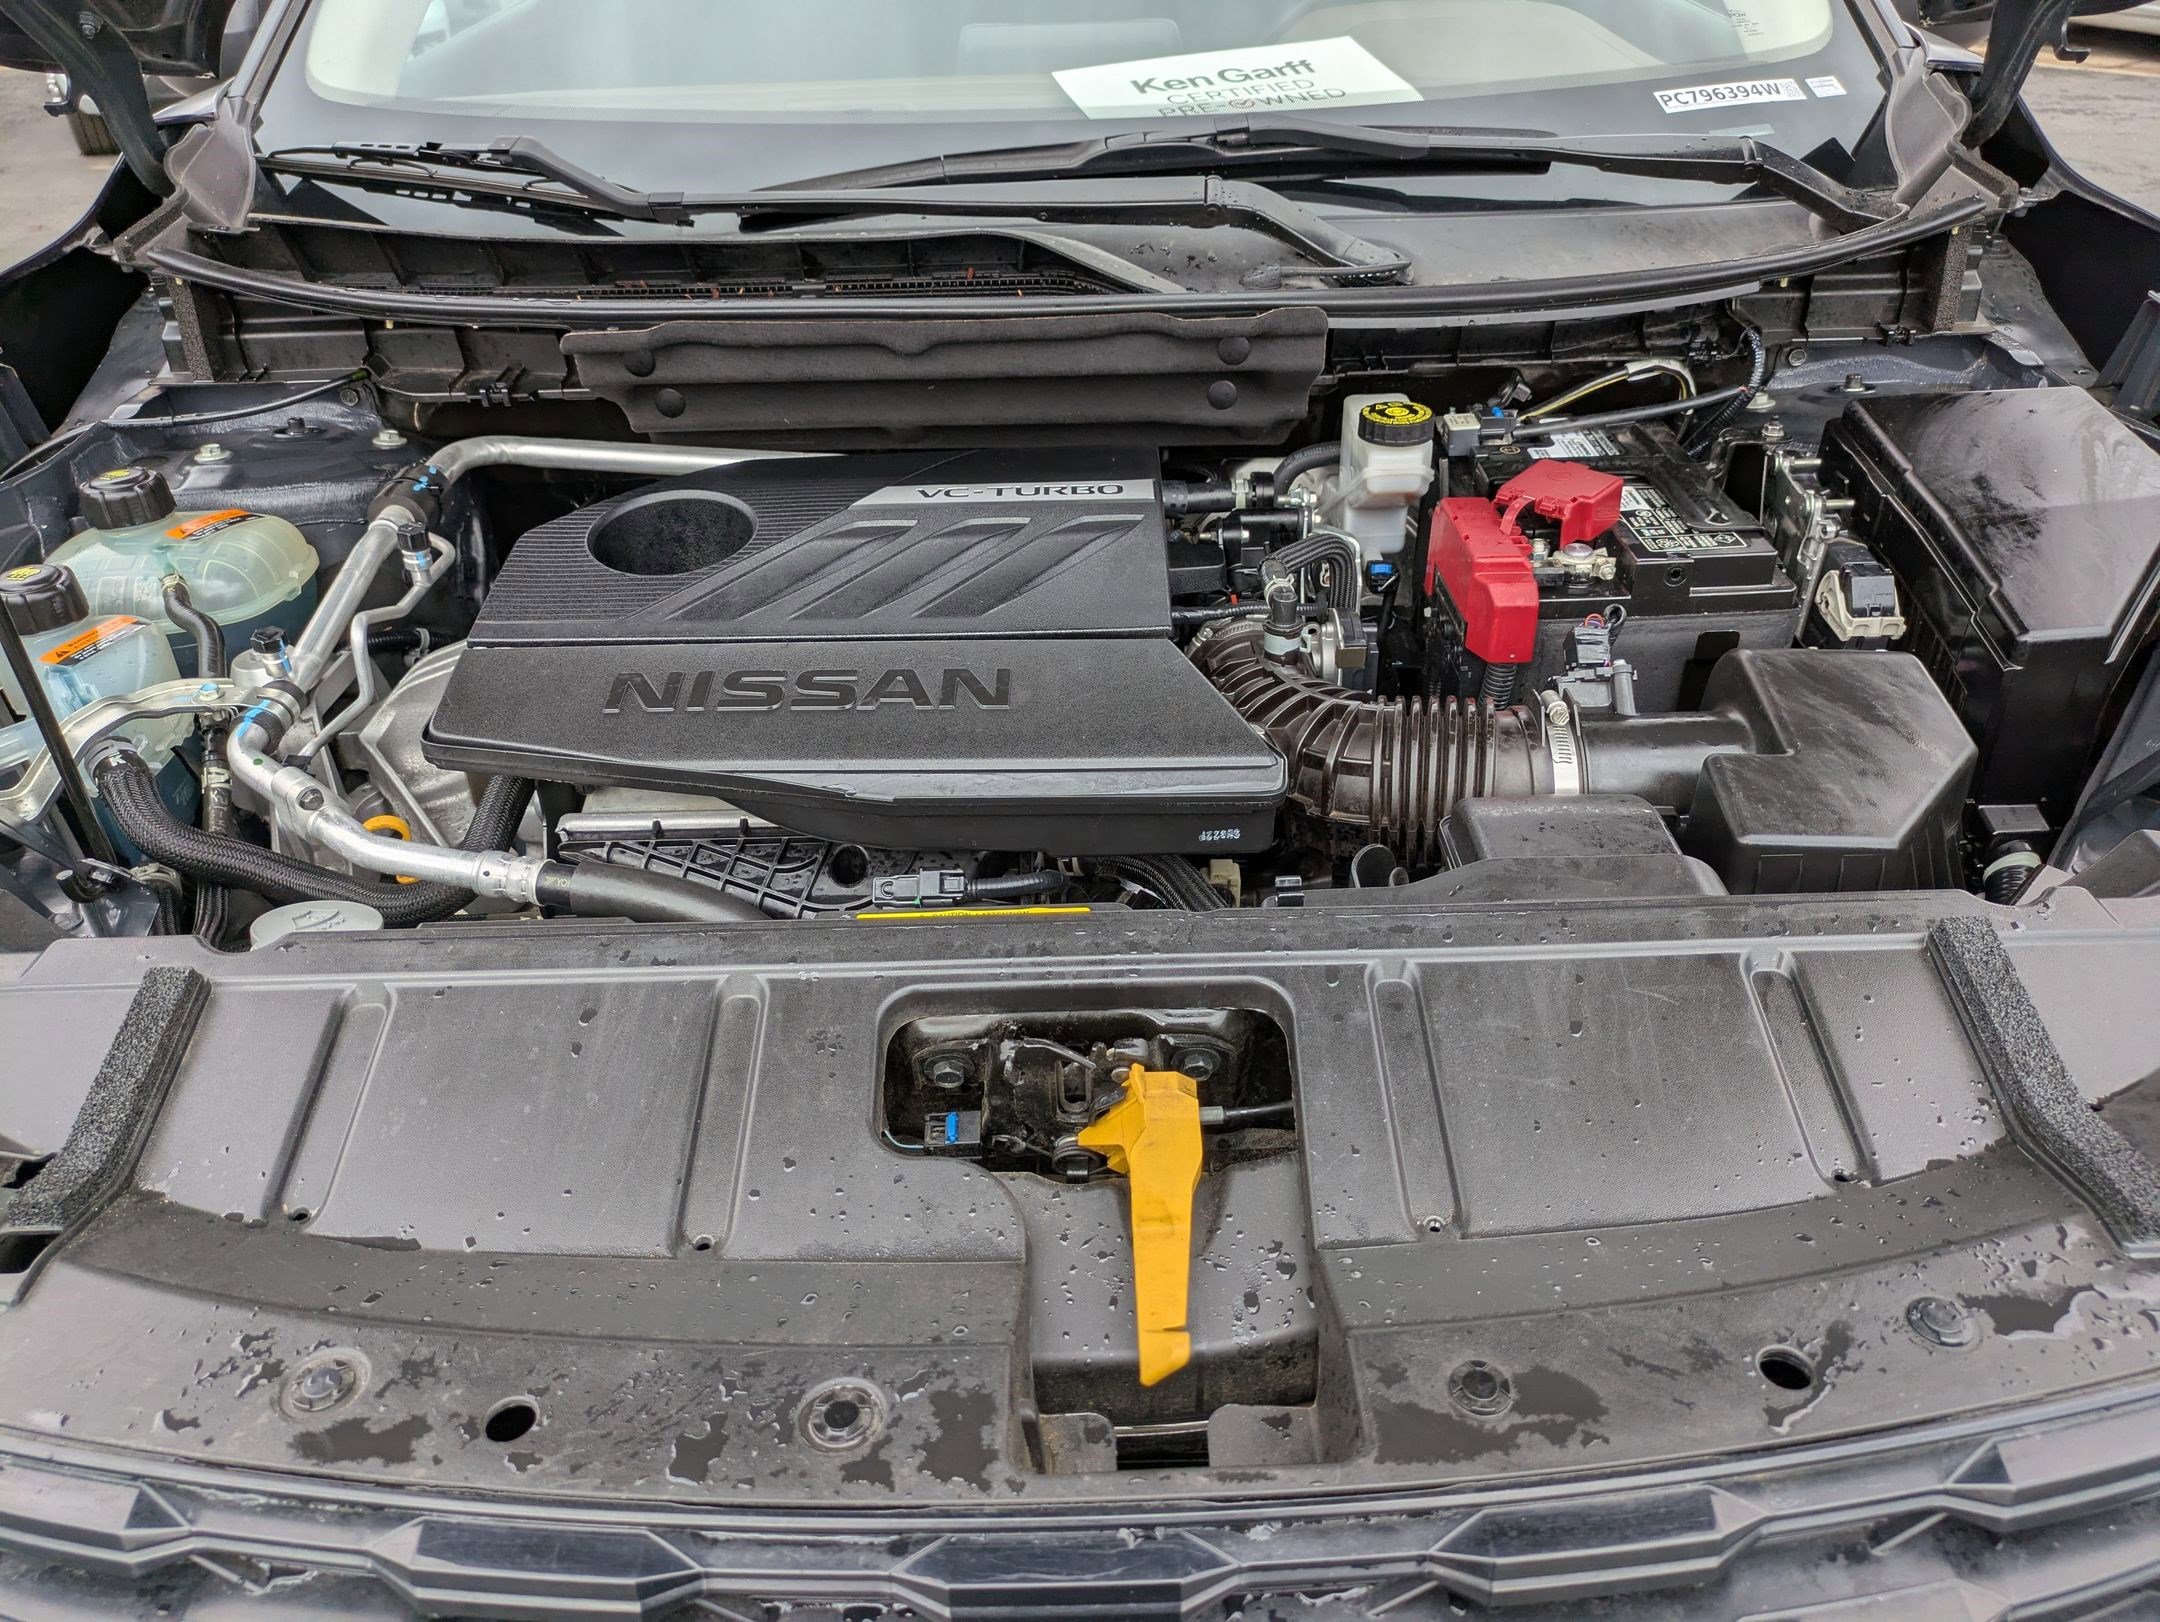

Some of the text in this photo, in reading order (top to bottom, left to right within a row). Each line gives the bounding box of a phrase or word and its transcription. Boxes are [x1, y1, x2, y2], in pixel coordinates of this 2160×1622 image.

[1129, 59, 1316, 94] Ken Garff
[1167, 79, 1315, 104] CERTIFIED
[1659, 82, 1781, 106] PC796394W
[916, 483, 1124, 499] VC-TURBO
[602, 667, 1012, 714] NISSAN
